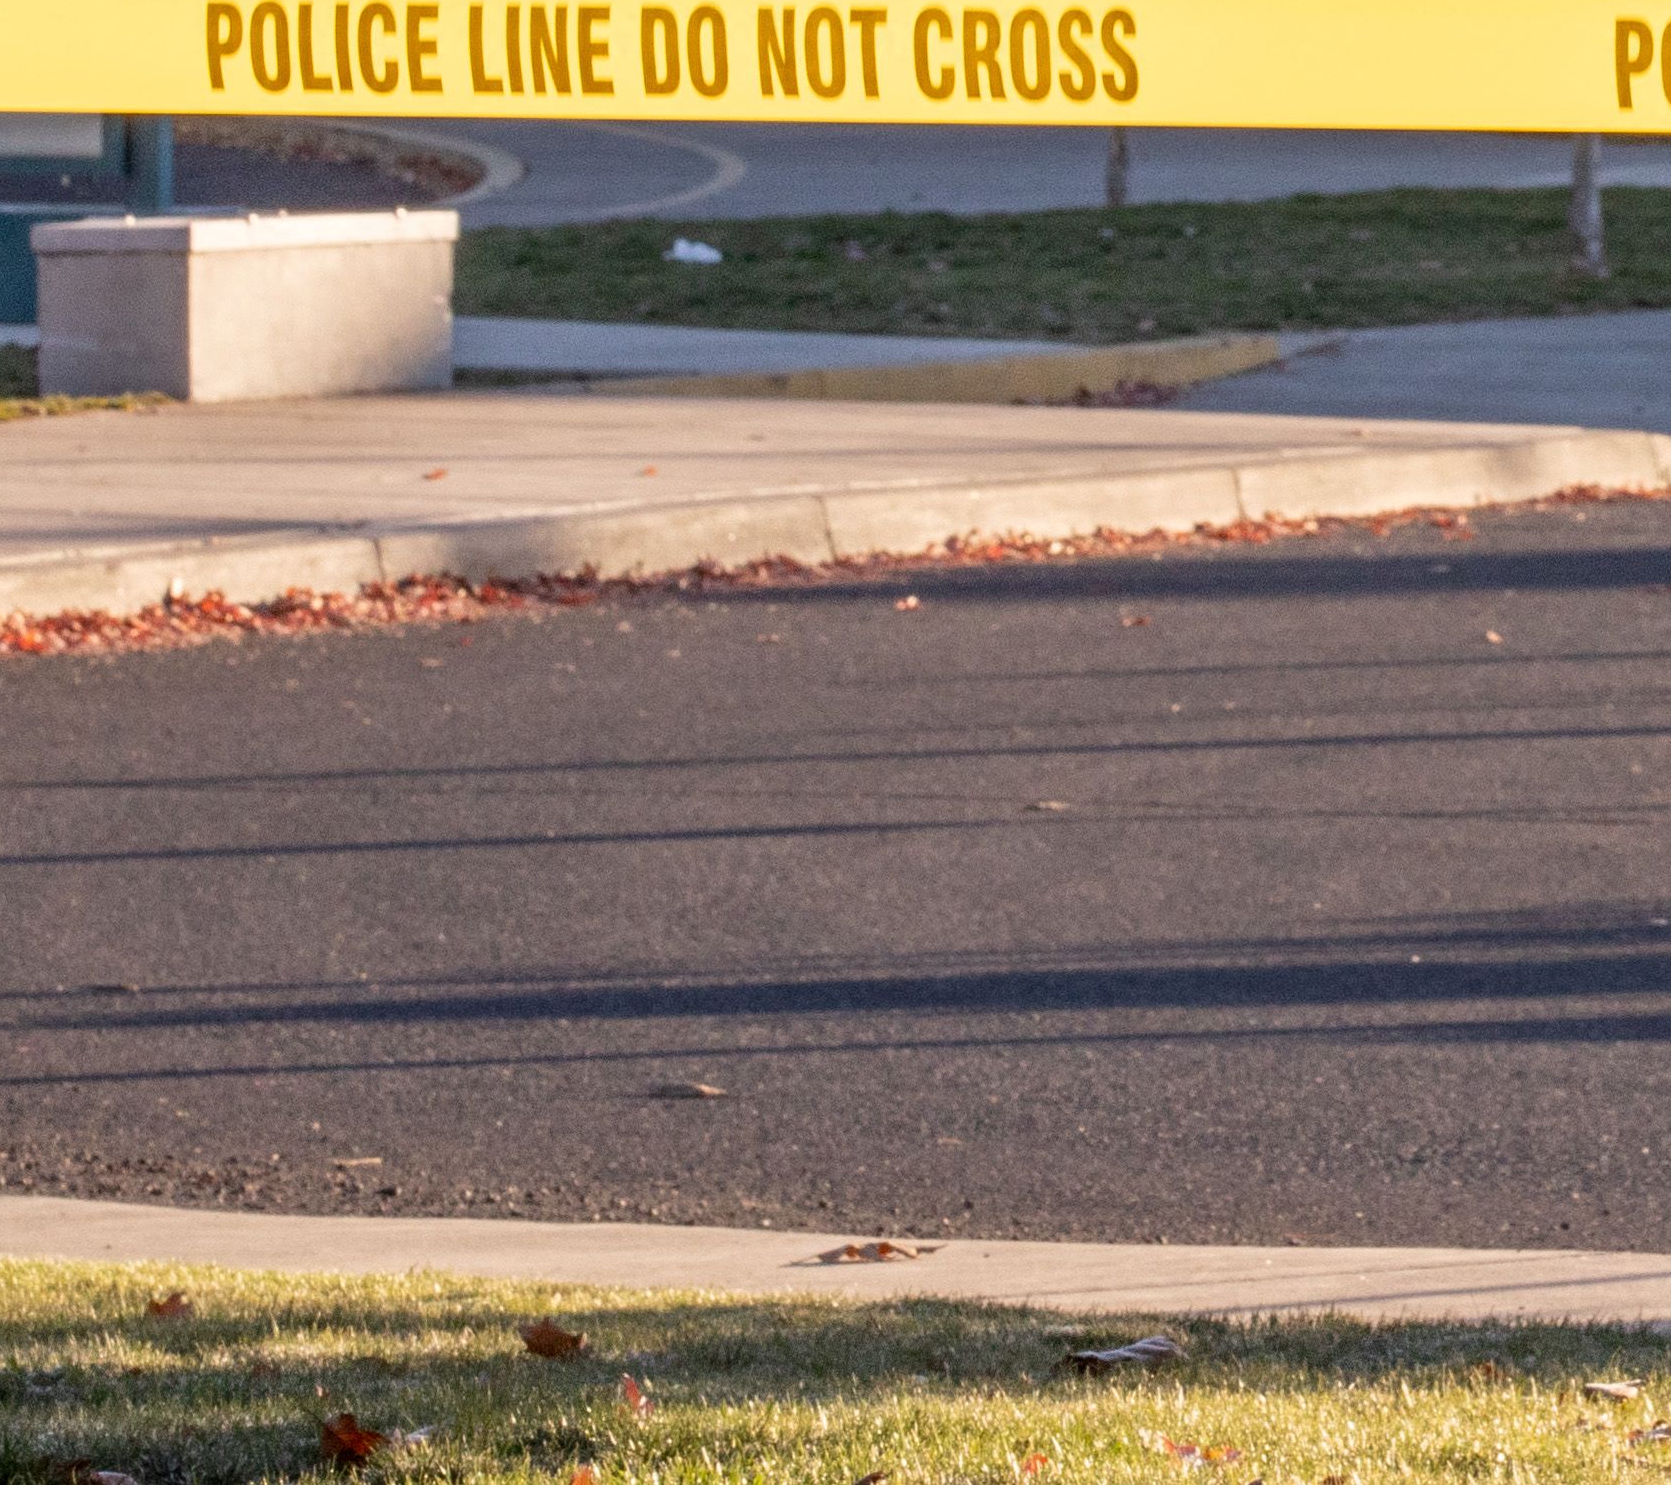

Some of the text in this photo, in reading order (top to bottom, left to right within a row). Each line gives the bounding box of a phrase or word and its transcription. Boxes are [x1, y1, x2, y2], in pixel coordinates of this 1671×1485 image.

[207, 2, 1138, 101] POLICE LINE DO NOT CROSS
